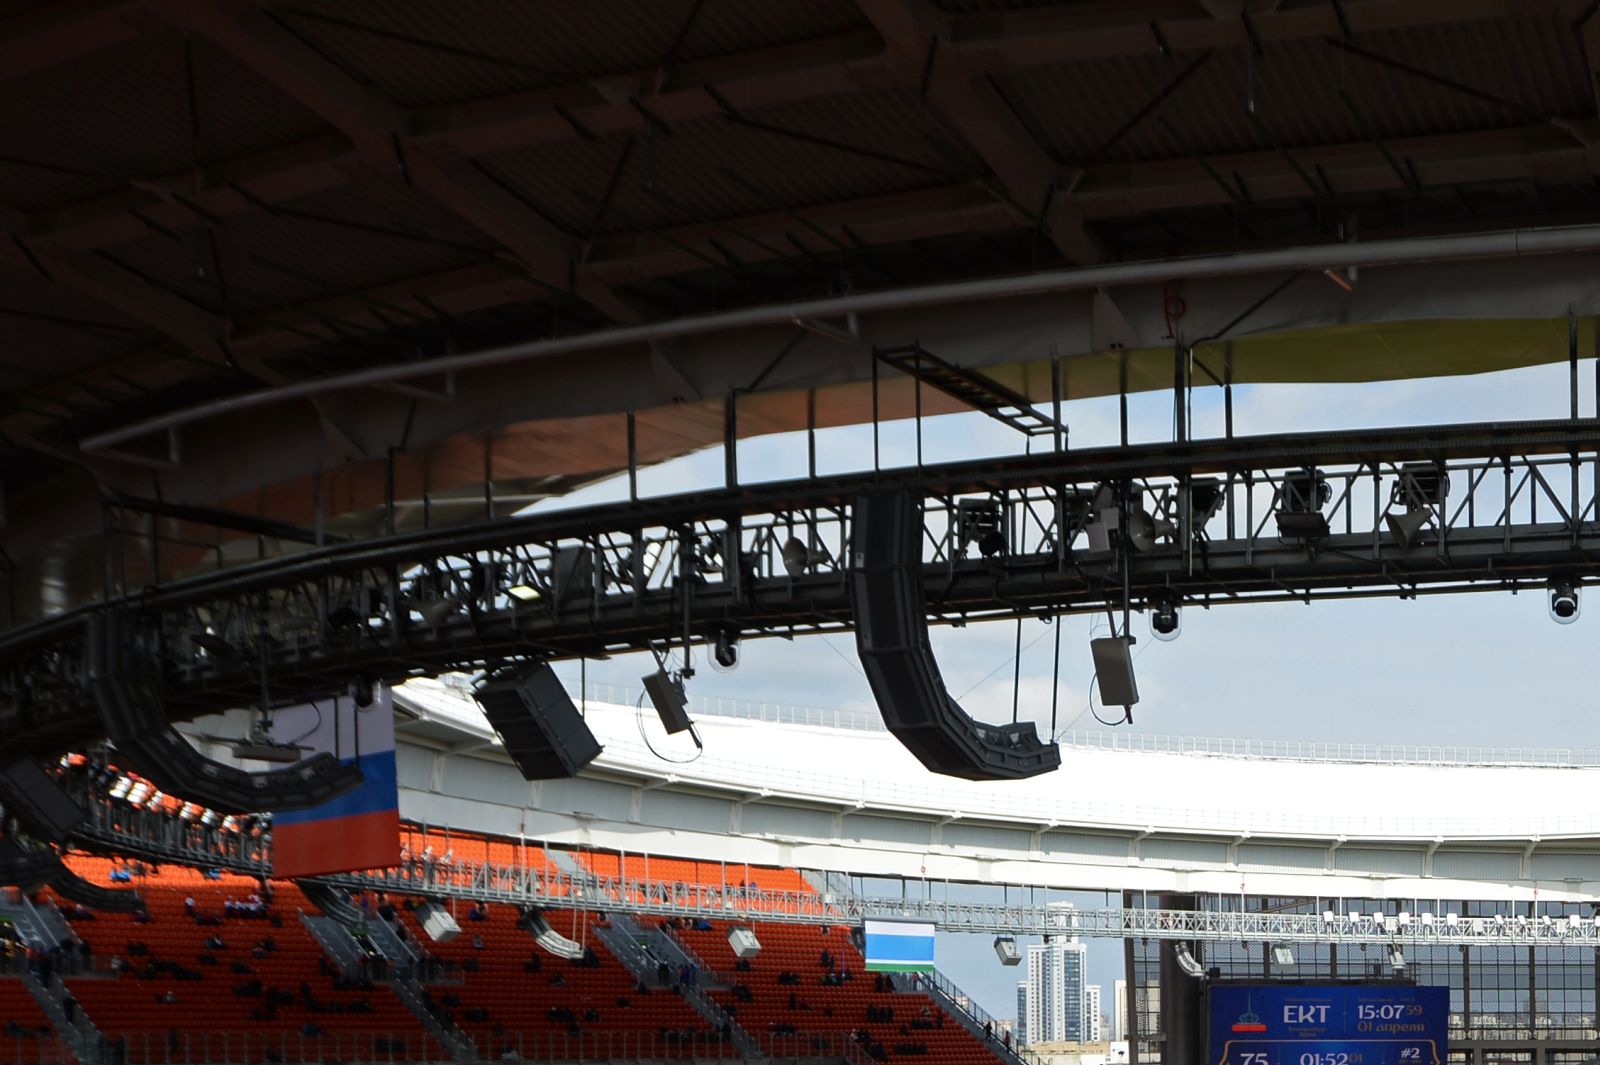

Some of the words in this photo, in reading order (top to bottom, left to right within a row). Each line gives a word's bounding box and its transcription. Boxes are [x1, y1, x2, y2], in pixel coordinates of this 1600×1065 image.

[1357, 1005, 1405, 1020] 15:07
[1406, 1005, 1424, 1015] 59
[1375, 1022, 1425, 1035] апреля
[1400, 1048, 1420, 1059] #2
